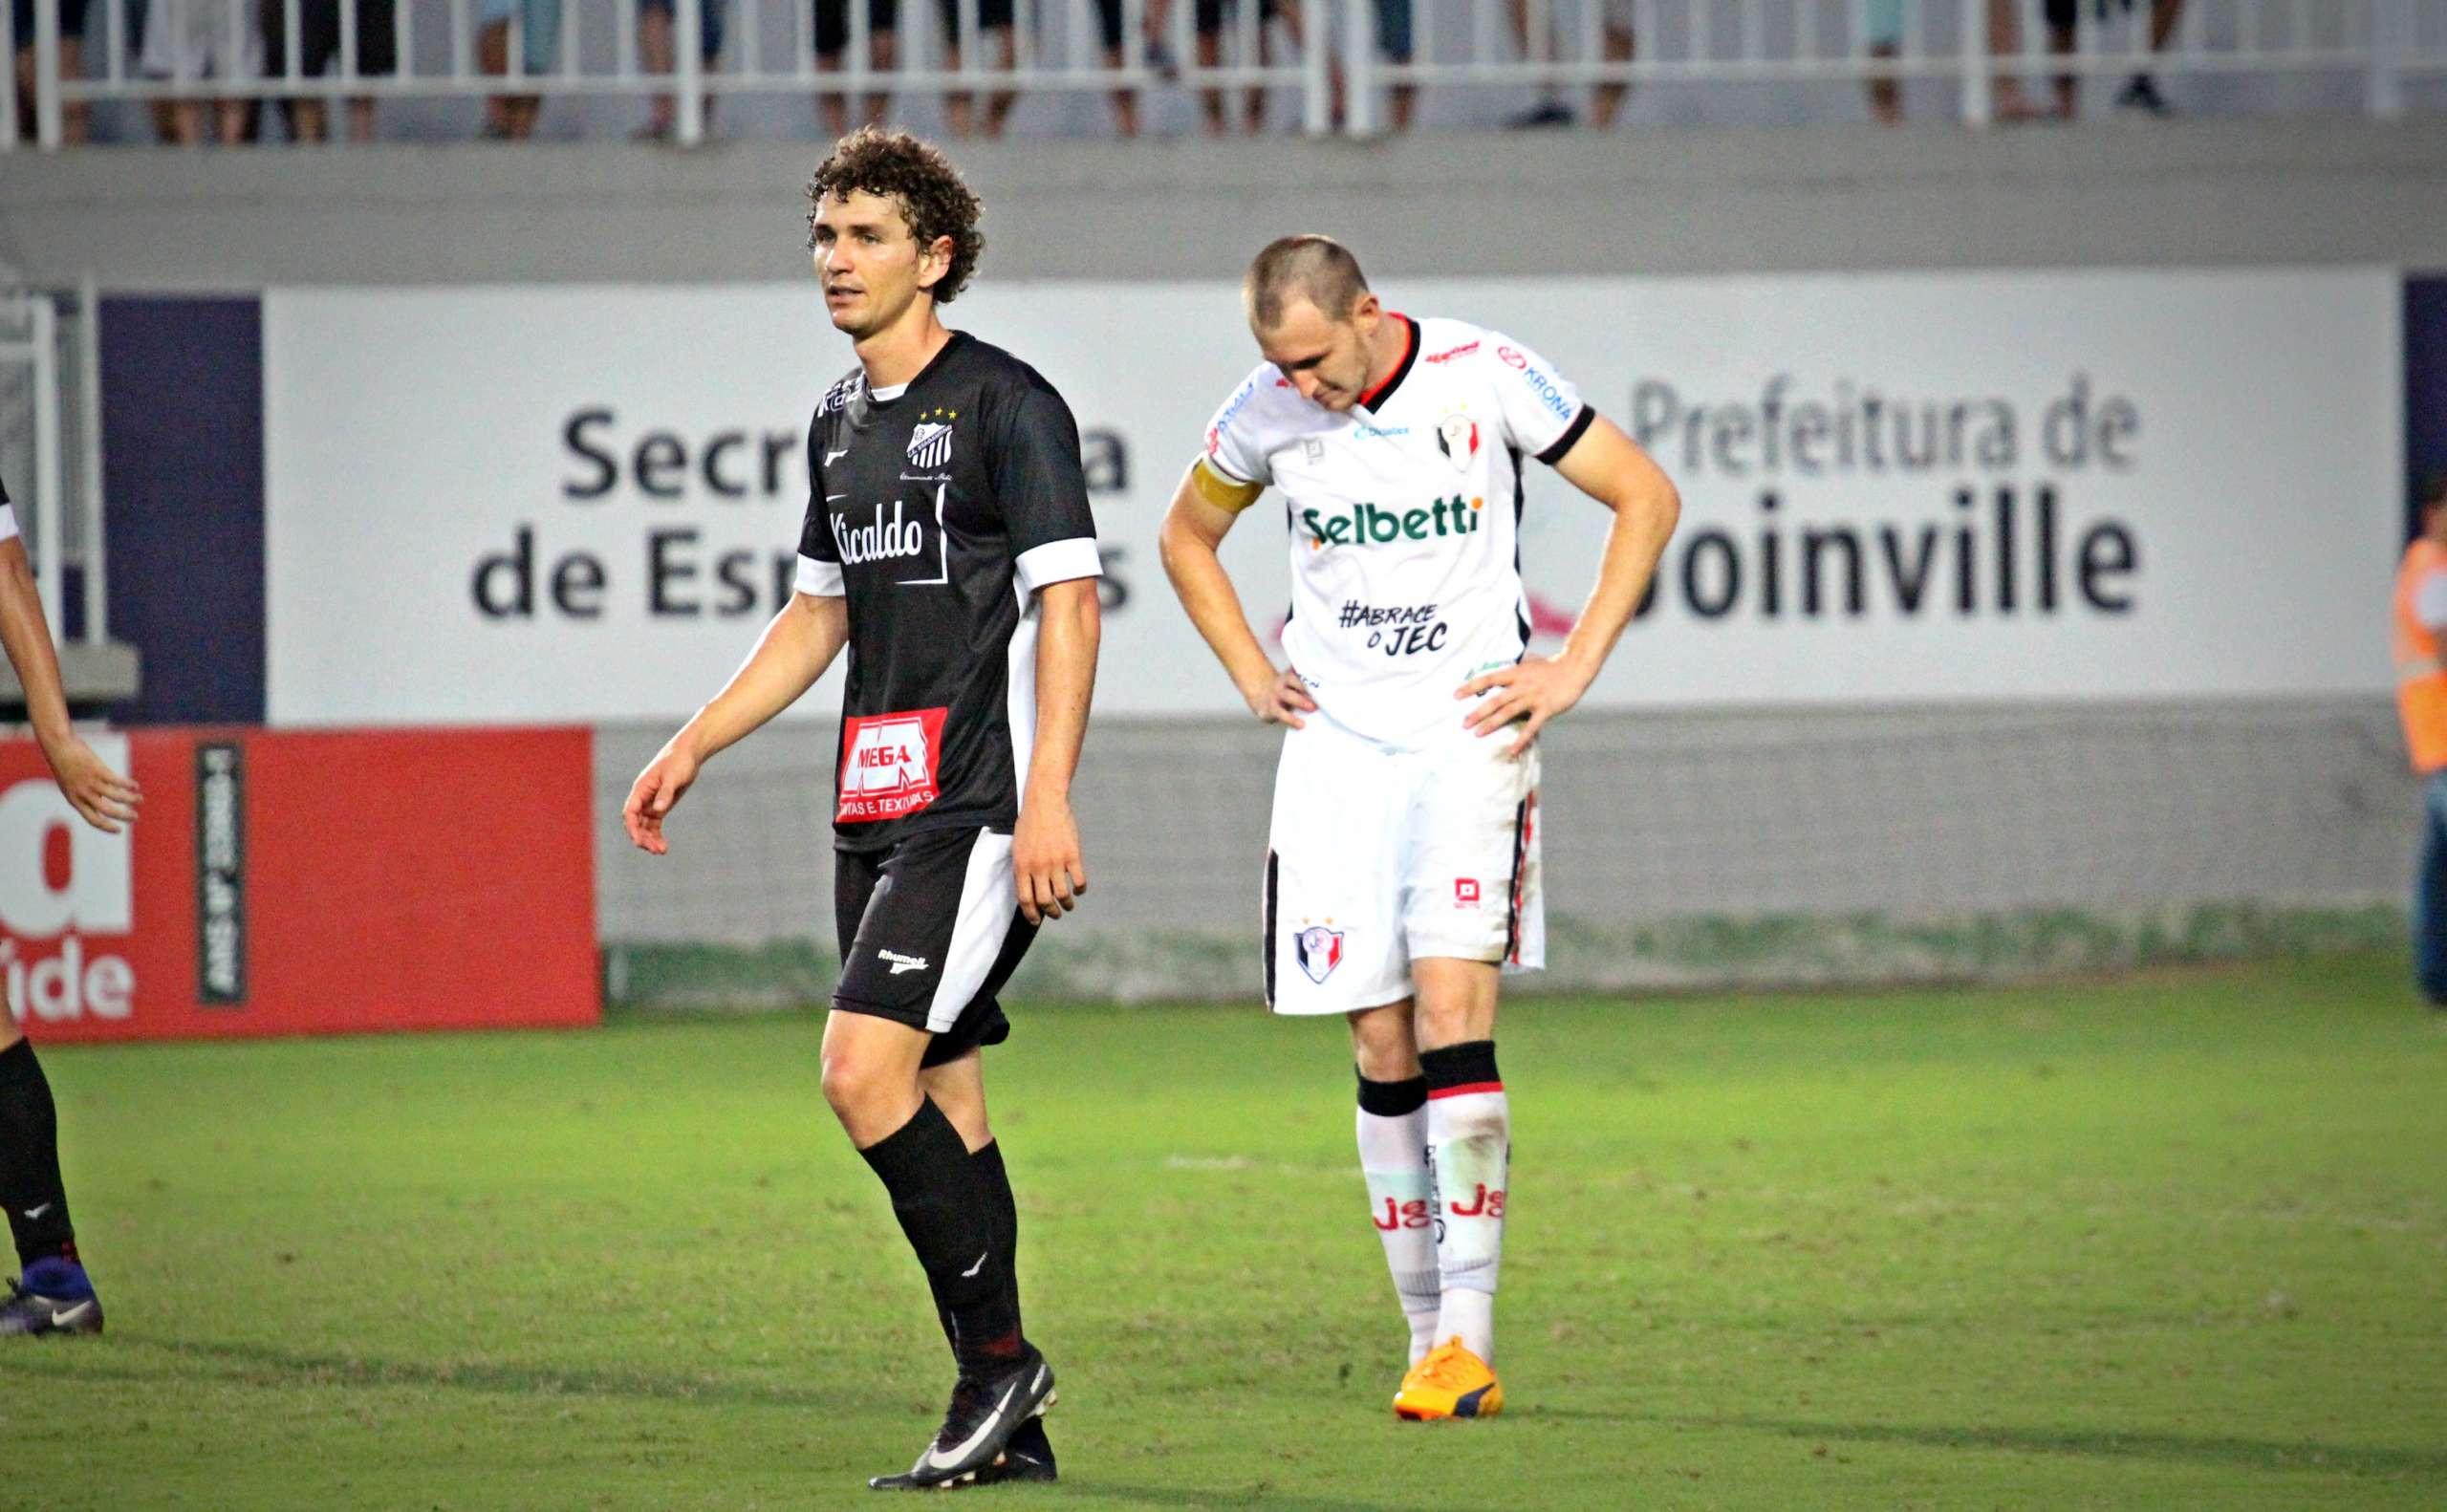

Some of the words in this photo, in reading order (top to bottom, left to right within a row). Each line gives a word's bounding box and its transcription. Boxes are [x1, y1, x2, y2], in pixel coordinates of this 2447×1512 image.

[1523, 367, 1571, 421] KRONA
[1630, 375, 2017, 472] Prefeitura
[2041, 374, 2139, 469] de
[1303, 493, 1483, 550] Selbetti
[472, 526, 606, 618] de
[1339, 600, 1439, 628] #ABRACE
[1385, 622, 1448, 657] JEC
[857, 745, 913, 768] MEGA
[867, 802, 877, 814] E
